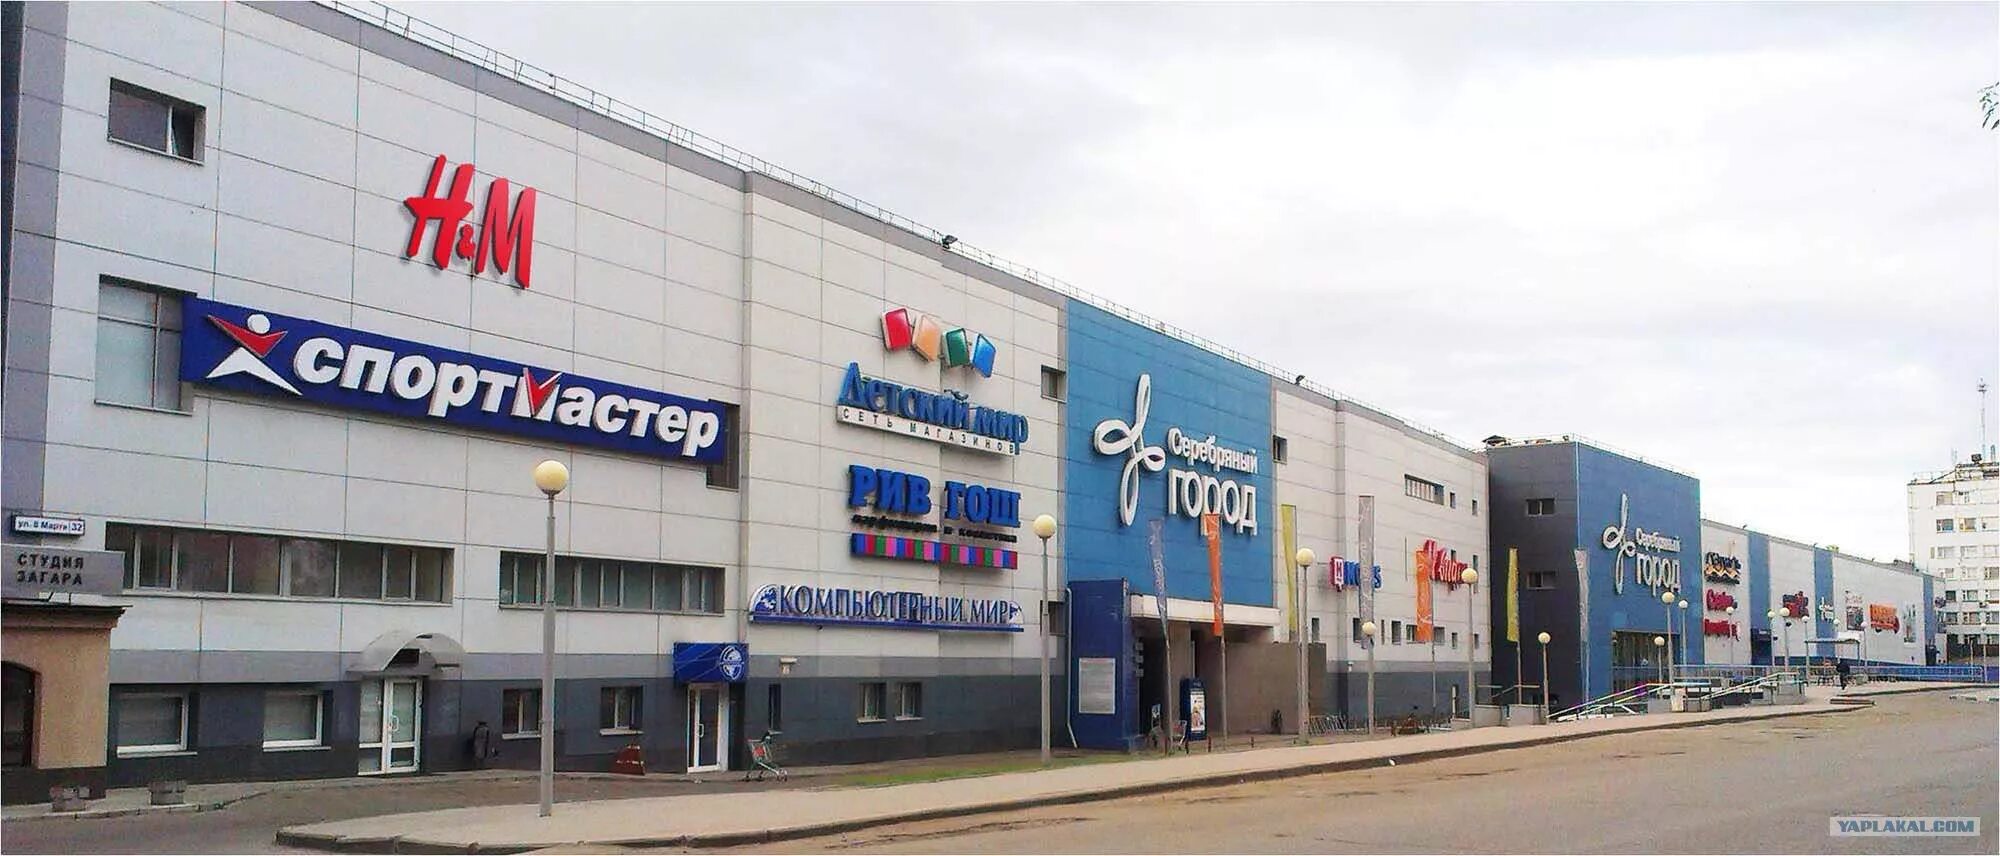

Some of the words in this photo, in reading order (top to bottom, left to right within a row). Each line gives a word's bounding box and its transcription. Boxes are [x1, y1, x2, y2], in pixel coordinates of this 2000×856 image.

[403, 153, 536, 289] H&M
[838, 362, 969, 429] Детский
[843, 408, 893, 427] СЕТЬ
[910, 422, 1014, 454] МАГАЗИНОВ
[1168, 427, 1258, 474] Серебряный
[849, 464, 931, 516] РИВ
[944, 480, 1022, 528] ГОШ
[71, 522, 83, 532] 32
[17, 552, 84, 570] СТУДИЯ
[17, 570, 83, 585] ЗАГАРА
[779, 584, 963, 624] КОМПЬЮТЕРНЫЙ
[971, 599, 1009, 625] МИР
